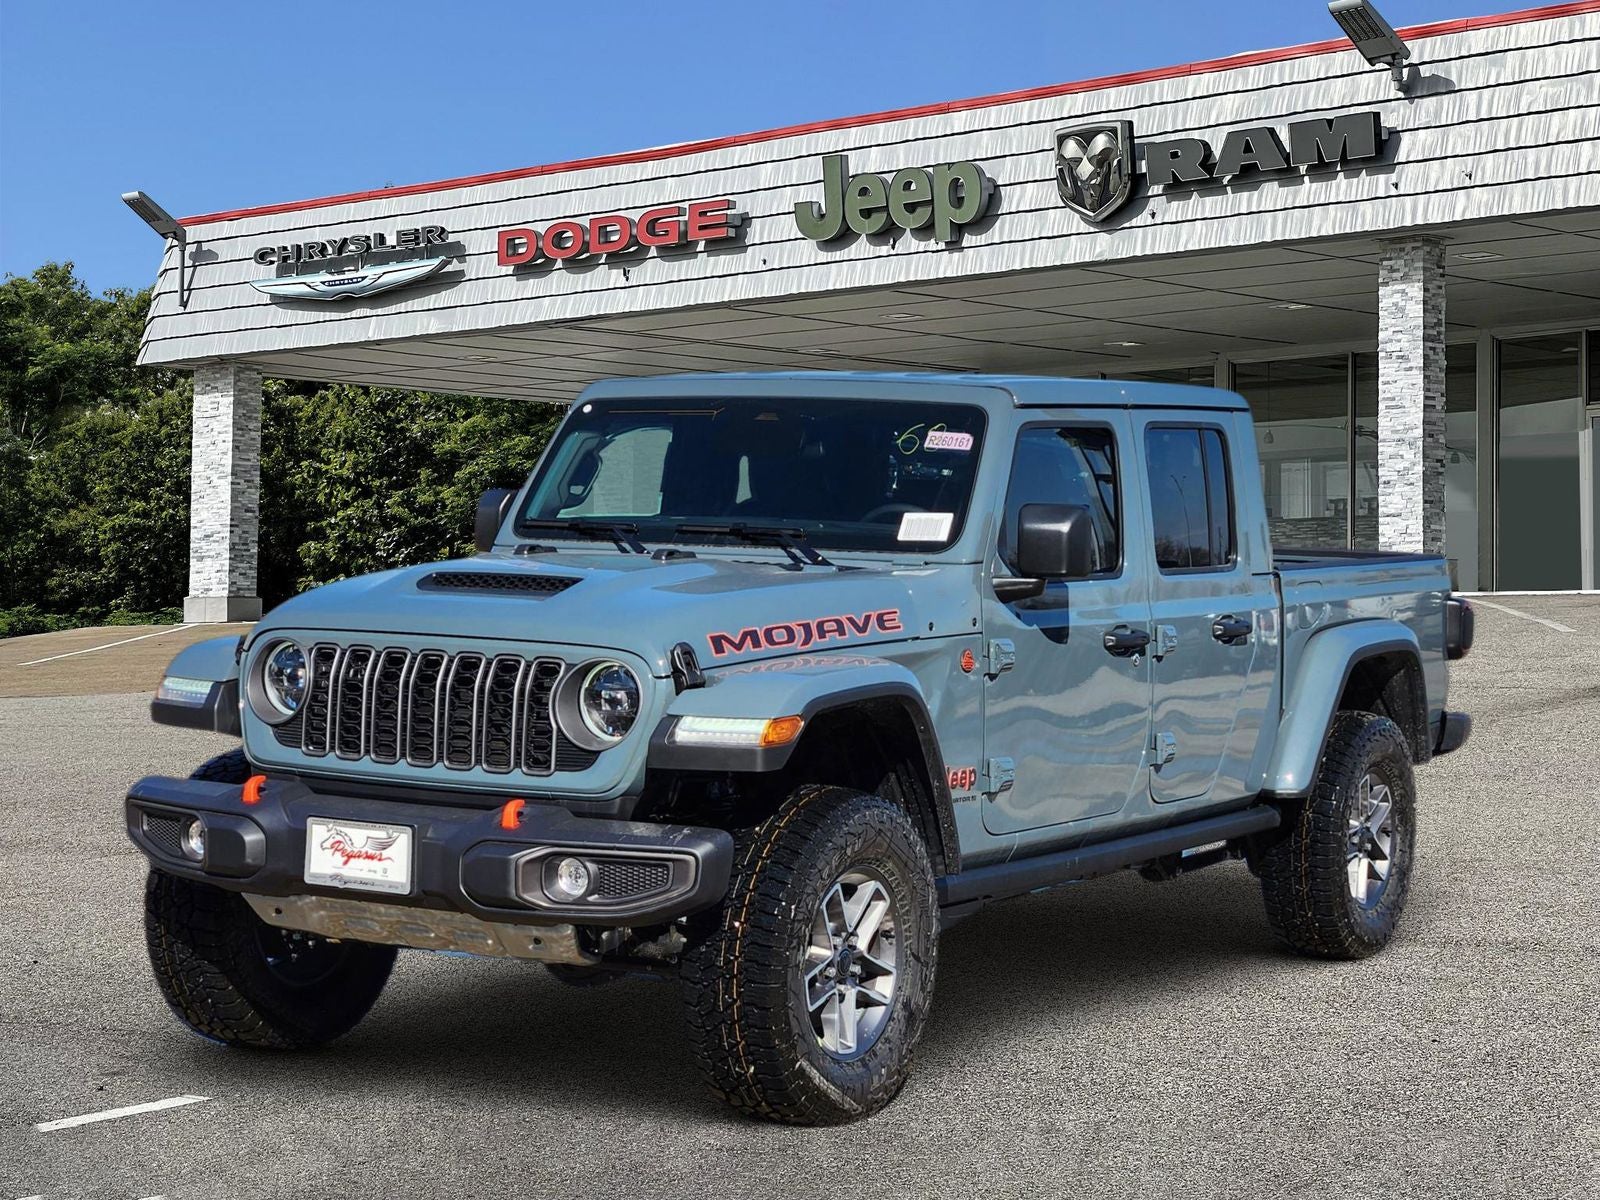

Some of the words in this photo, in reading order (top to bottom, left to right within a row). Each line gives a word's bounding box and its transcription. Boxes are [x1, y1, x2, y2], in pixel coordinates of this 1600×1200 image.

[1145, 112, 1381, 186] RAM
[794, 154, 986, 242] Jeep
[253, 224, 450, 266] CHRYSLER
[498, 200, 736, 267] DODGE
[928, 435, 972, 448] R260161
[706, 608, 903, 657] MOJAVE
[330, 839, 395, 866] Pegasus
